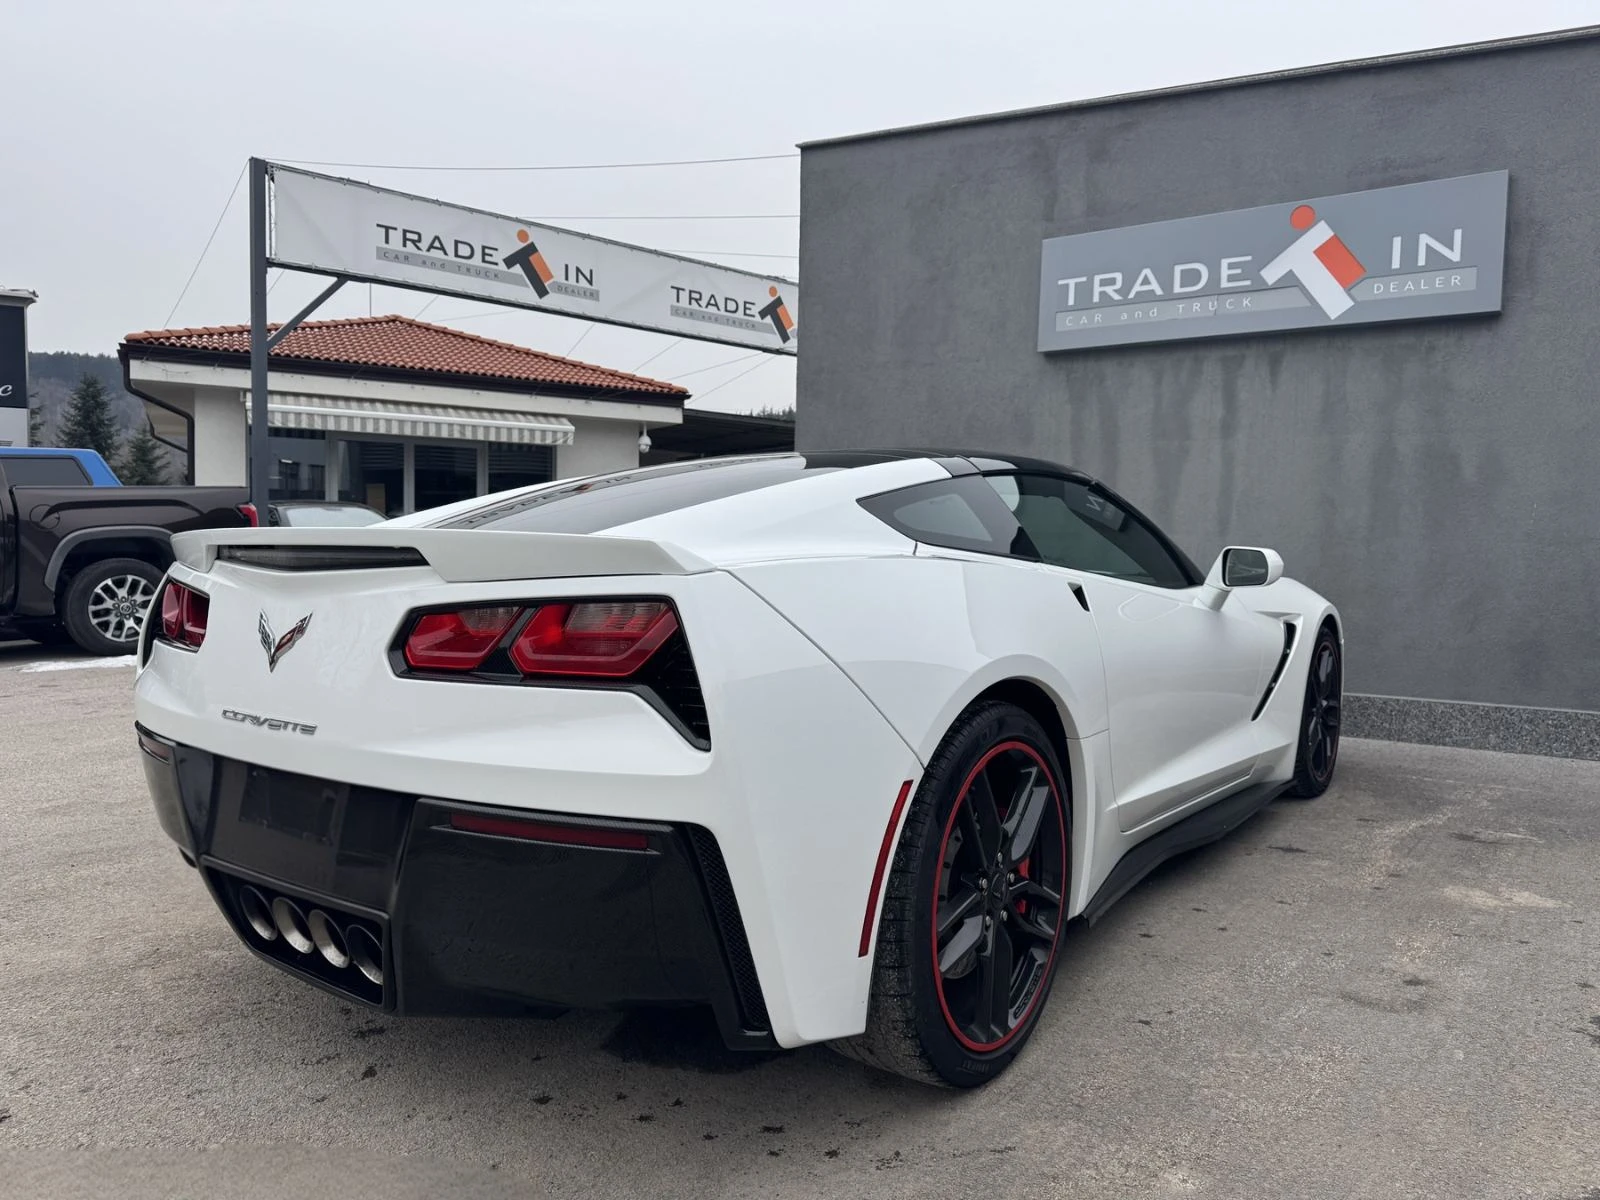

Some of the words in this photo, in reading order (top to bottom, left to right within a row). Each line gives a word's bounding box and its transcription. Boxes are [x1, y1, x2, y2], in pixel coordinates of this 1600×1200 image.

[376, 223, 499, 266] TRADE
[564, 263, 593, 287] IN
[383, 251, 410, 263] CAR
[422, 259, 446, 270] and
[456, 264, 500, 280] TRUCK
[557, 284, 594, 298] DEALER
[1058, 255, 1253, 307] TRADE
[1391, 228, 1463, 270] IN
[670, 285, 756, 318] TRADE
[674, 308, 694, 317] CAR
[725, 317, 756, 329] TRUCK
[1064, 311, 1103, 327] CAR
[1119, 305, 1158, 320] and
[1177, 295, 1255, 314] TRUCK
[1373, 274, 1463, 295] DEALER
[221, 709, 318, 736] CORVETTE
